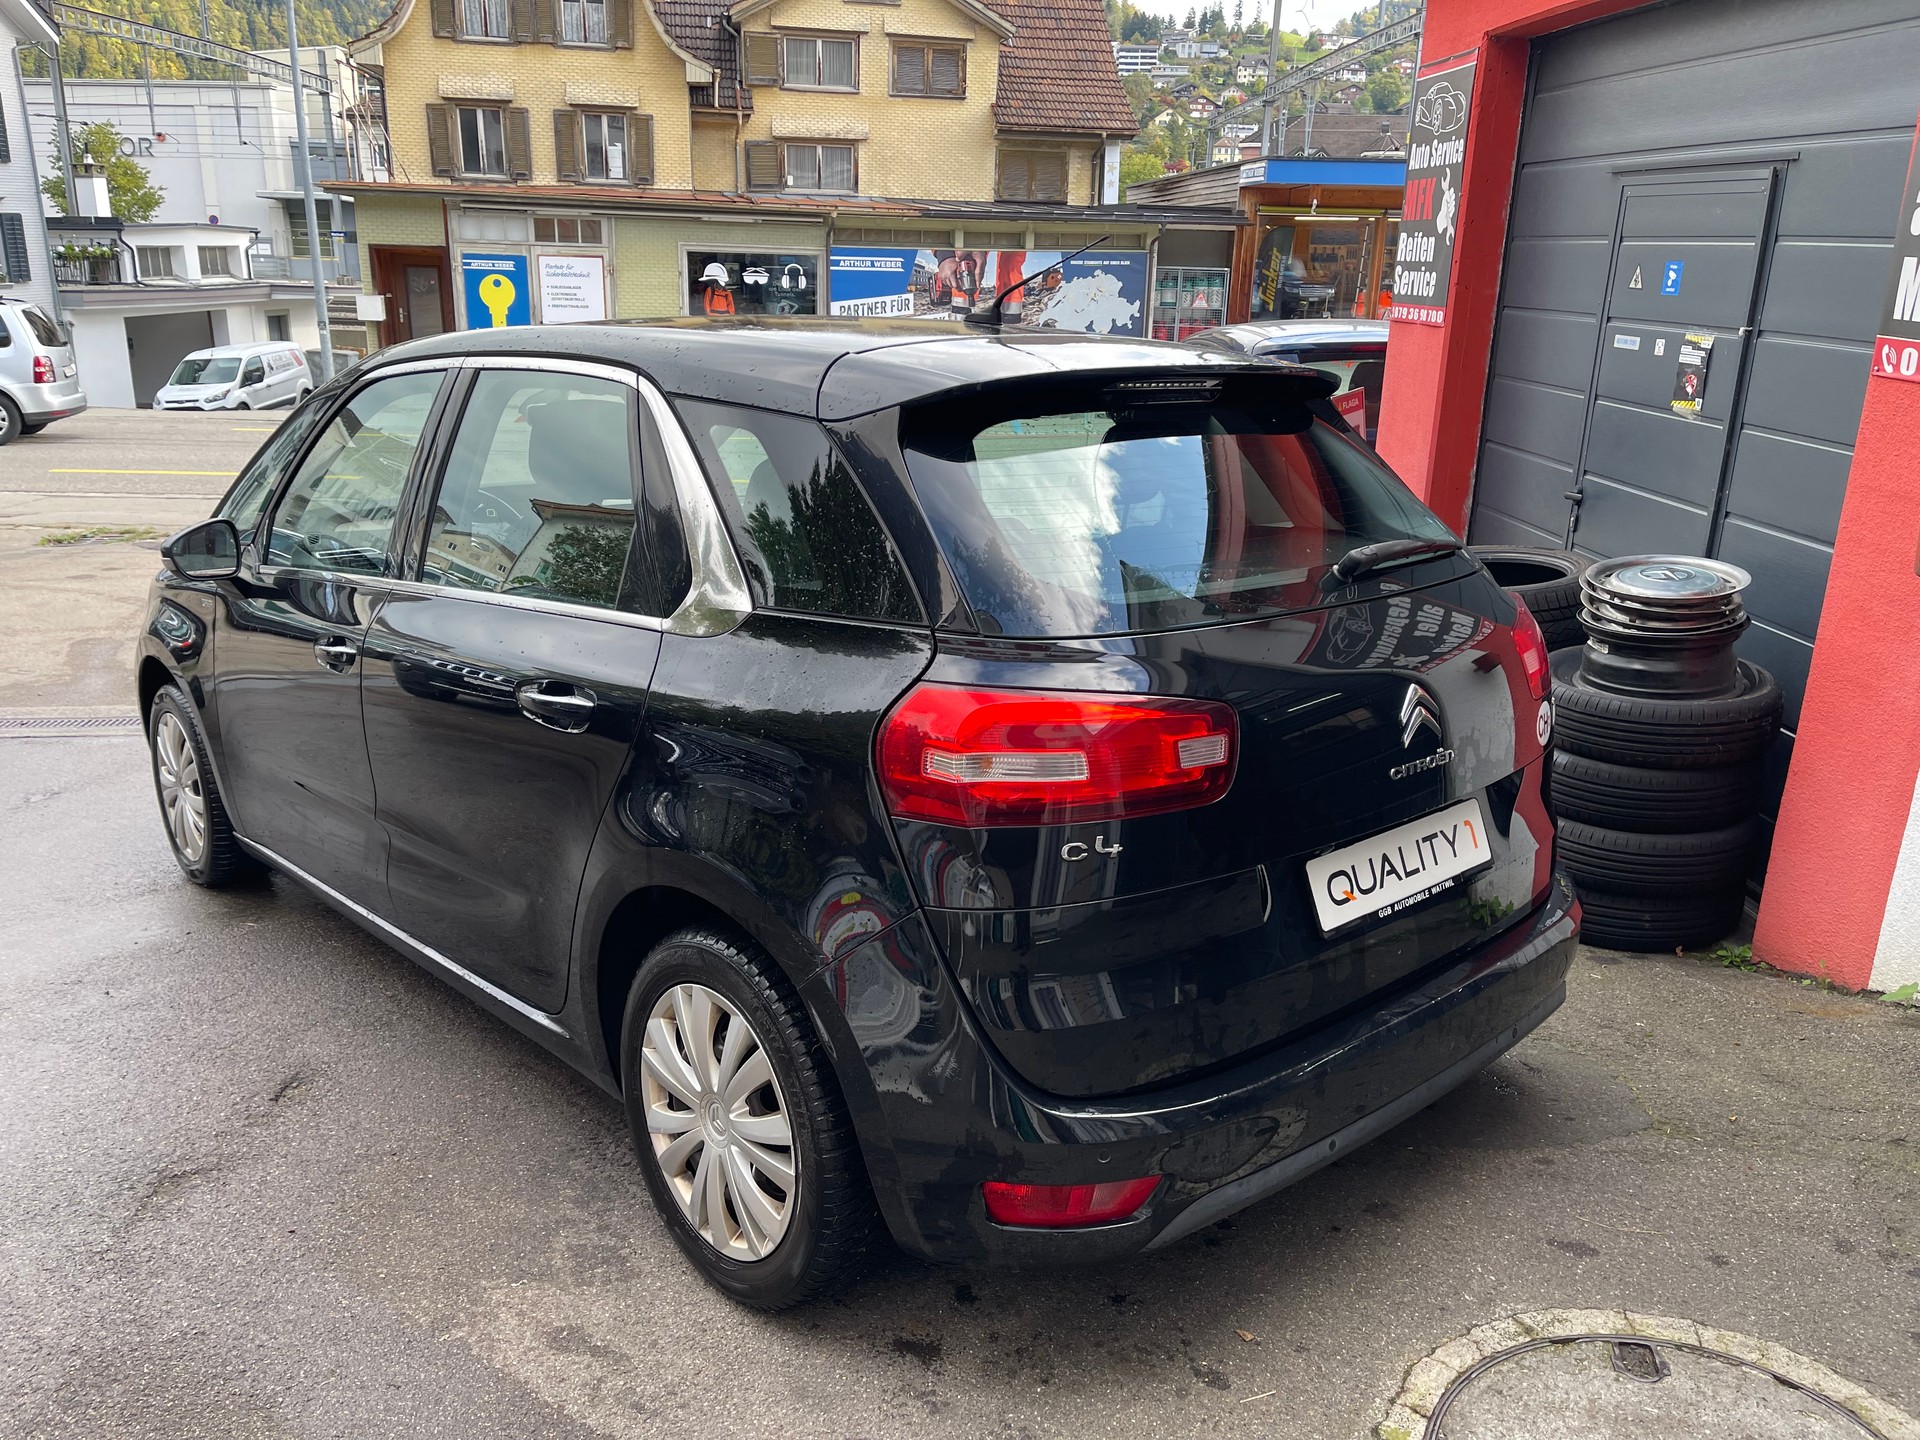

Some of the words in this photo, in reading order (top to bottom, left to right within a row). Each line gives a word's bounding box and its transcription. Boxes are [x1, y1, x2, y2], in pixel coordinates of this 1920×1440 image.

[1408, 143, 1430, 170] Auto
[1430, 136, 1464, 168] Service
[1403, 177, 1437, 221] MFK
[1396, 232, 1435, 262] Reifen
[1393, 265, 1437, 297] Service
[839, 300, 887, 317] PARTNER
[890, 296, 910, 313] FÜR
[1342, 398, 1360, 410] FLAGA
[1538, 711, 1549, 738] CH
[1378, 905, 1392, 918] GGB
[1394, 890, 1430, 911] AUTOMOBILE
[1431, 878, 1455, 895] WATTWIL
